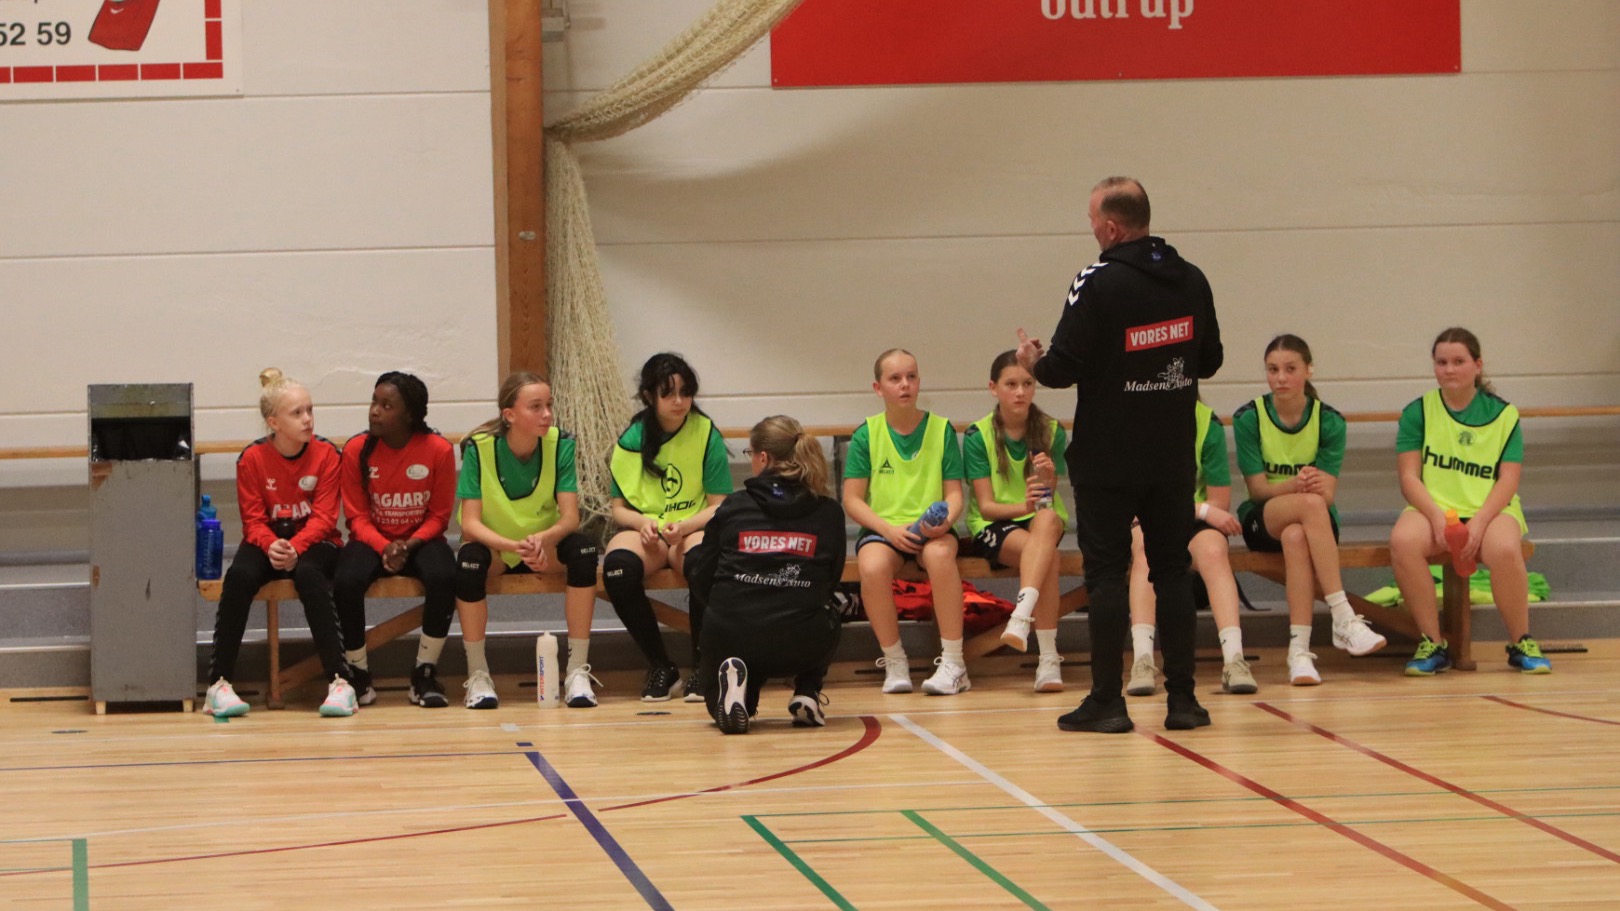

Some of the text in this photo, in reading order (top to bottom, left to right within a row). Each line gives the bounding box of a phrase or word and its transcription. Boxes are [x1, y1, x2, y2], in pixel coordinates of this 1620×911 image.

[37, 21, 71, 46] 59
[1130, 321, 1189, 347] VORES NET
[1124, 380, 1170, 392] Madsens
[1423, 445, 1499, 480] hummel
[743, 535, 813, 553] VORES NET
[734, 573, 782, 587] Madsens
